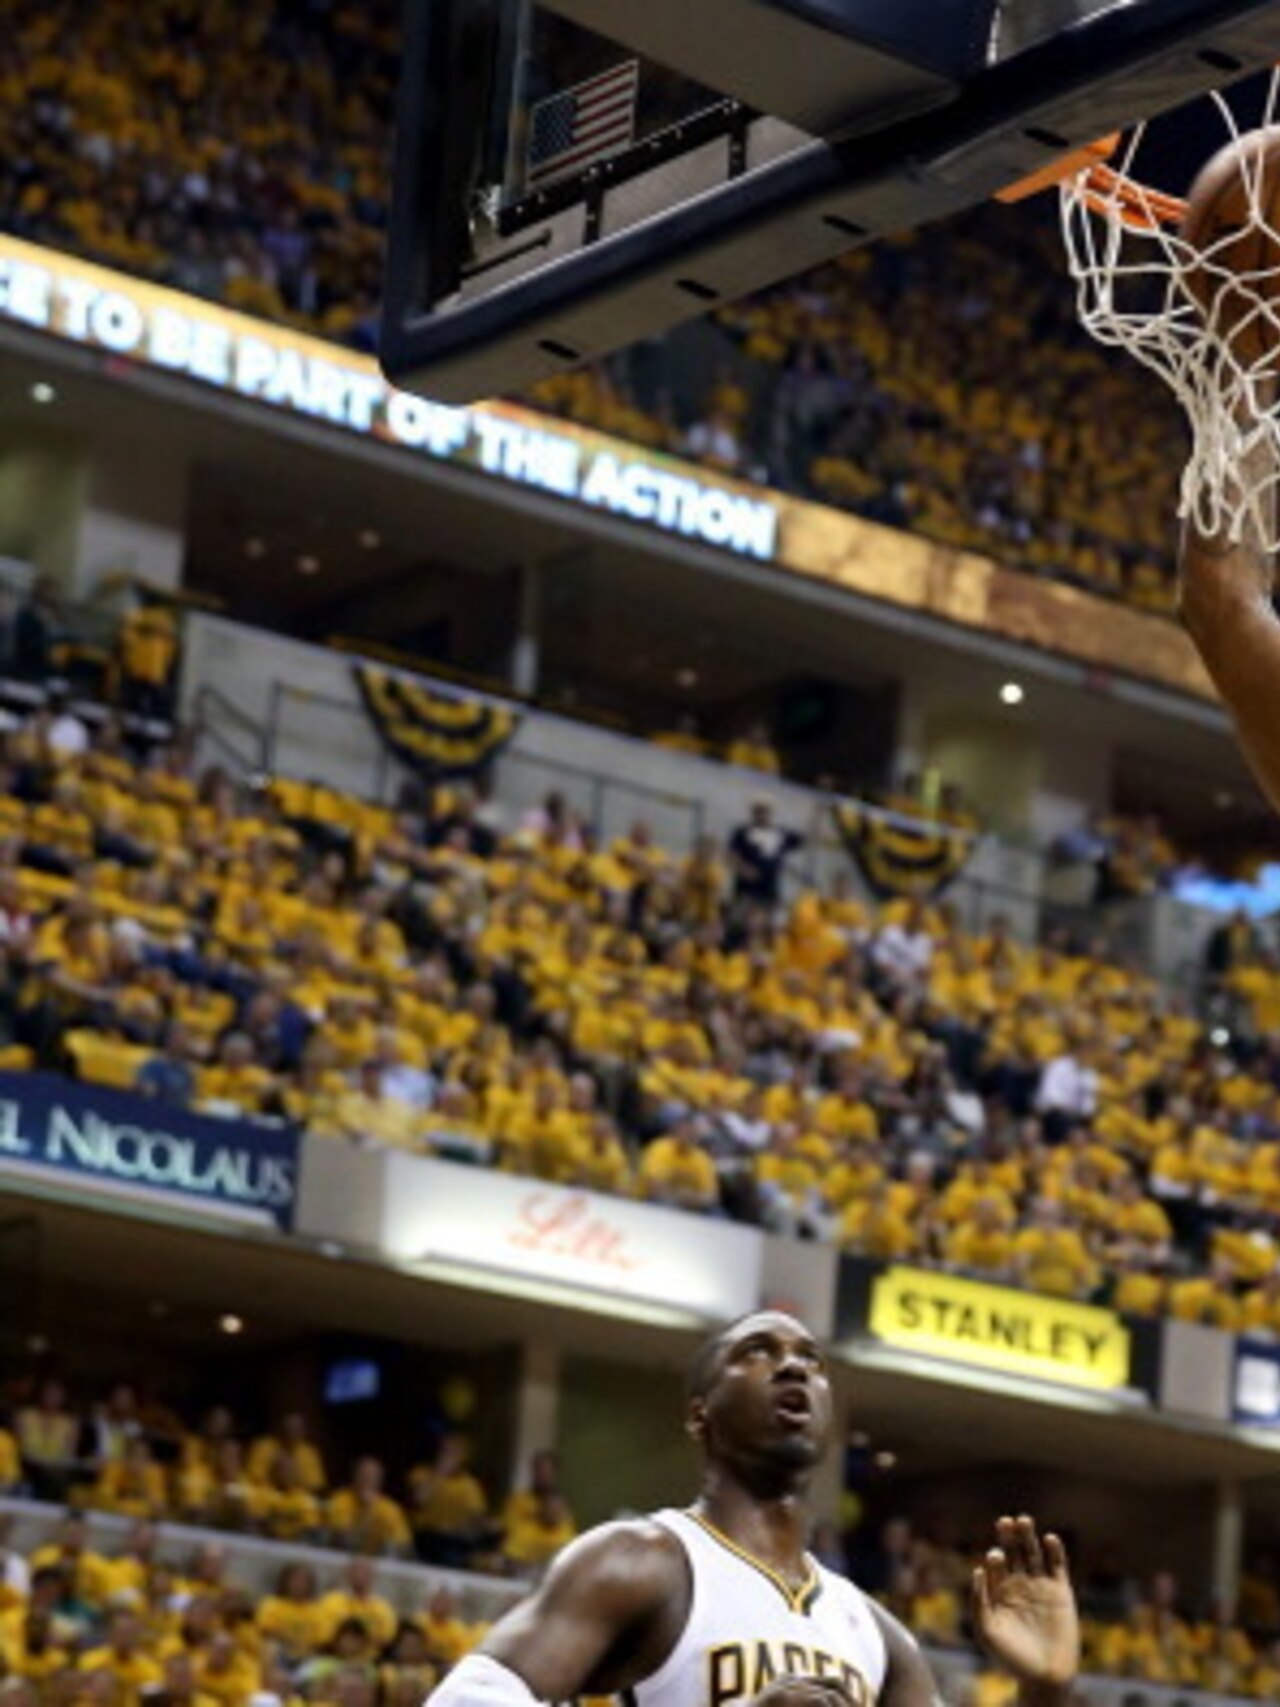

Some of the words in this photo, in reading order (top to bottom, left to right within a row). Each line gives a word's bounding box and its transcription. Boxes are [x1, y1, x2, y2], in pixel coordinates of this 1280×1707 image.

[58, 276, 142, 352] TO
[150, 304, 230, 387] BE
[235, 334, 383, 432] PART
[387, 391, 467, 457] OF
[471, 408, 579, 496] THE
[582, 453, 777, 561] ACTION
[47, 1104, 293, 1203] NICOLAUS
[897, 1290, 1108, 1367] STANLEY
